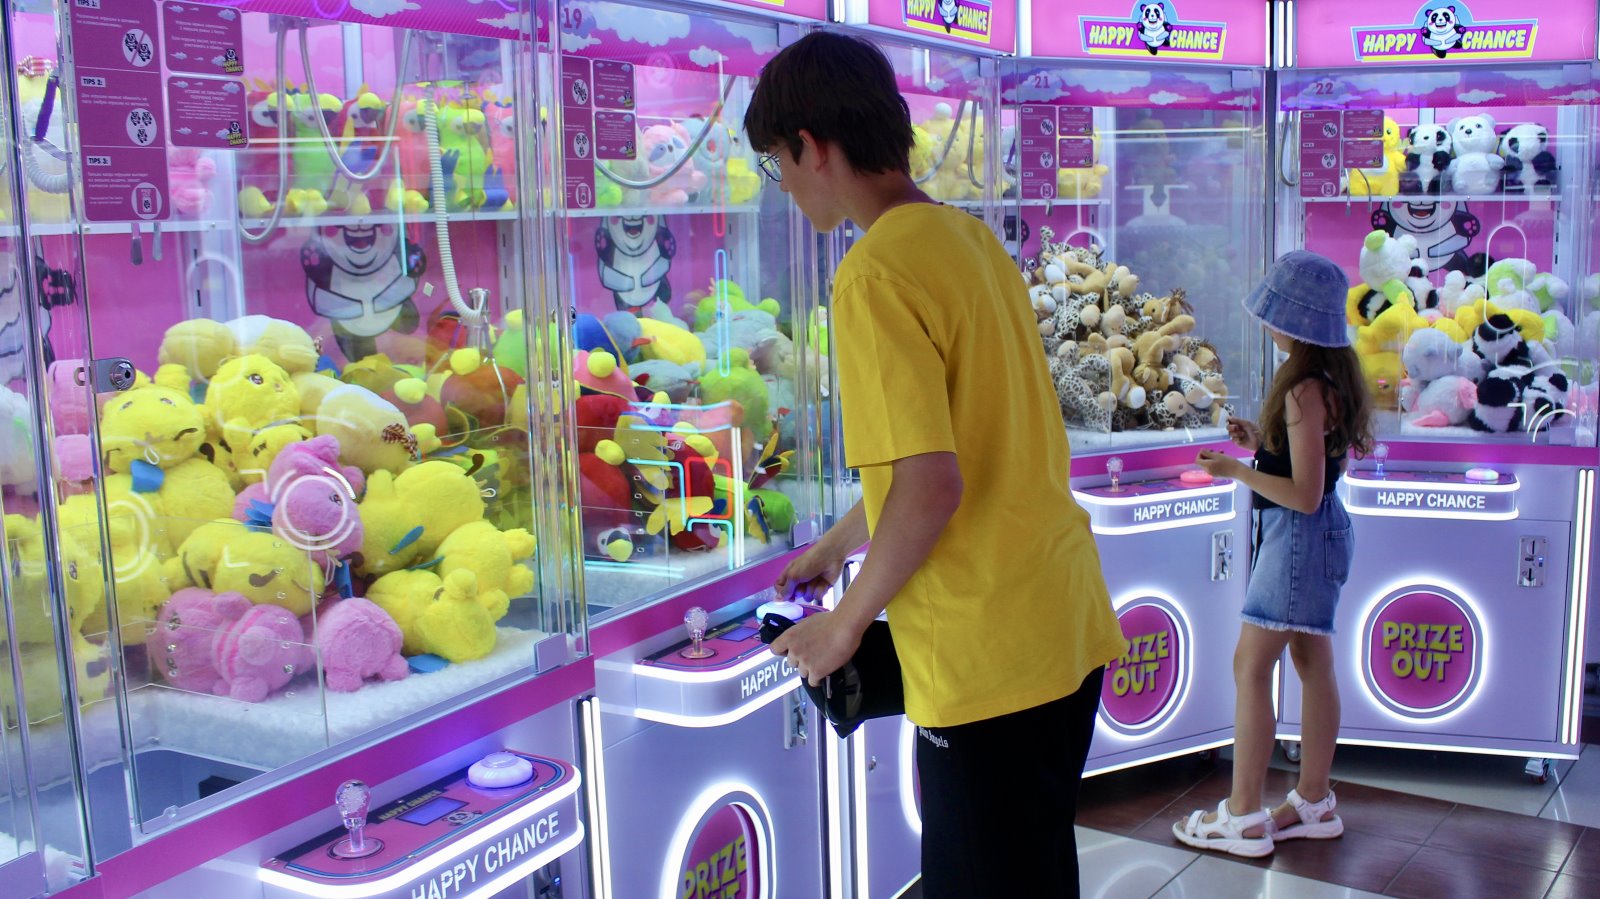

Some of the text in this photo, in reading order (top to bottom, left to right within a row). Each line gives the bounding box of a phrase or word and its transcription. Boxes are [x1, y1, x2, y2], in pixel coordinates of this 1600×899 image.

[563, 7, 583, 29] 19
[907, 0, 988, 32] HAPPY CHANCE
[1089, 25, 1219, 51] HAPPY CHANCE
[1363, 29, 1527, 53] HAPPY CHANCE
[1034, 75, 1050, 89] 21
[1315, 82, 1334, 95] 22
[1133, 497, 1220, 522] HAPPY CHANCE
[1377, 491, 1486, 509] HAPPY CHANCE
[1105, 631, 1169, 670] RIZE
[1382, 621, 1464, 652] PRIZE
[1112, 662, 1160, 696] OUT
[1392, 649, 1452, 682] OUT
[741, 661, 779, 699] HAPPY
[484, 810, 560, 874] CHANCE
